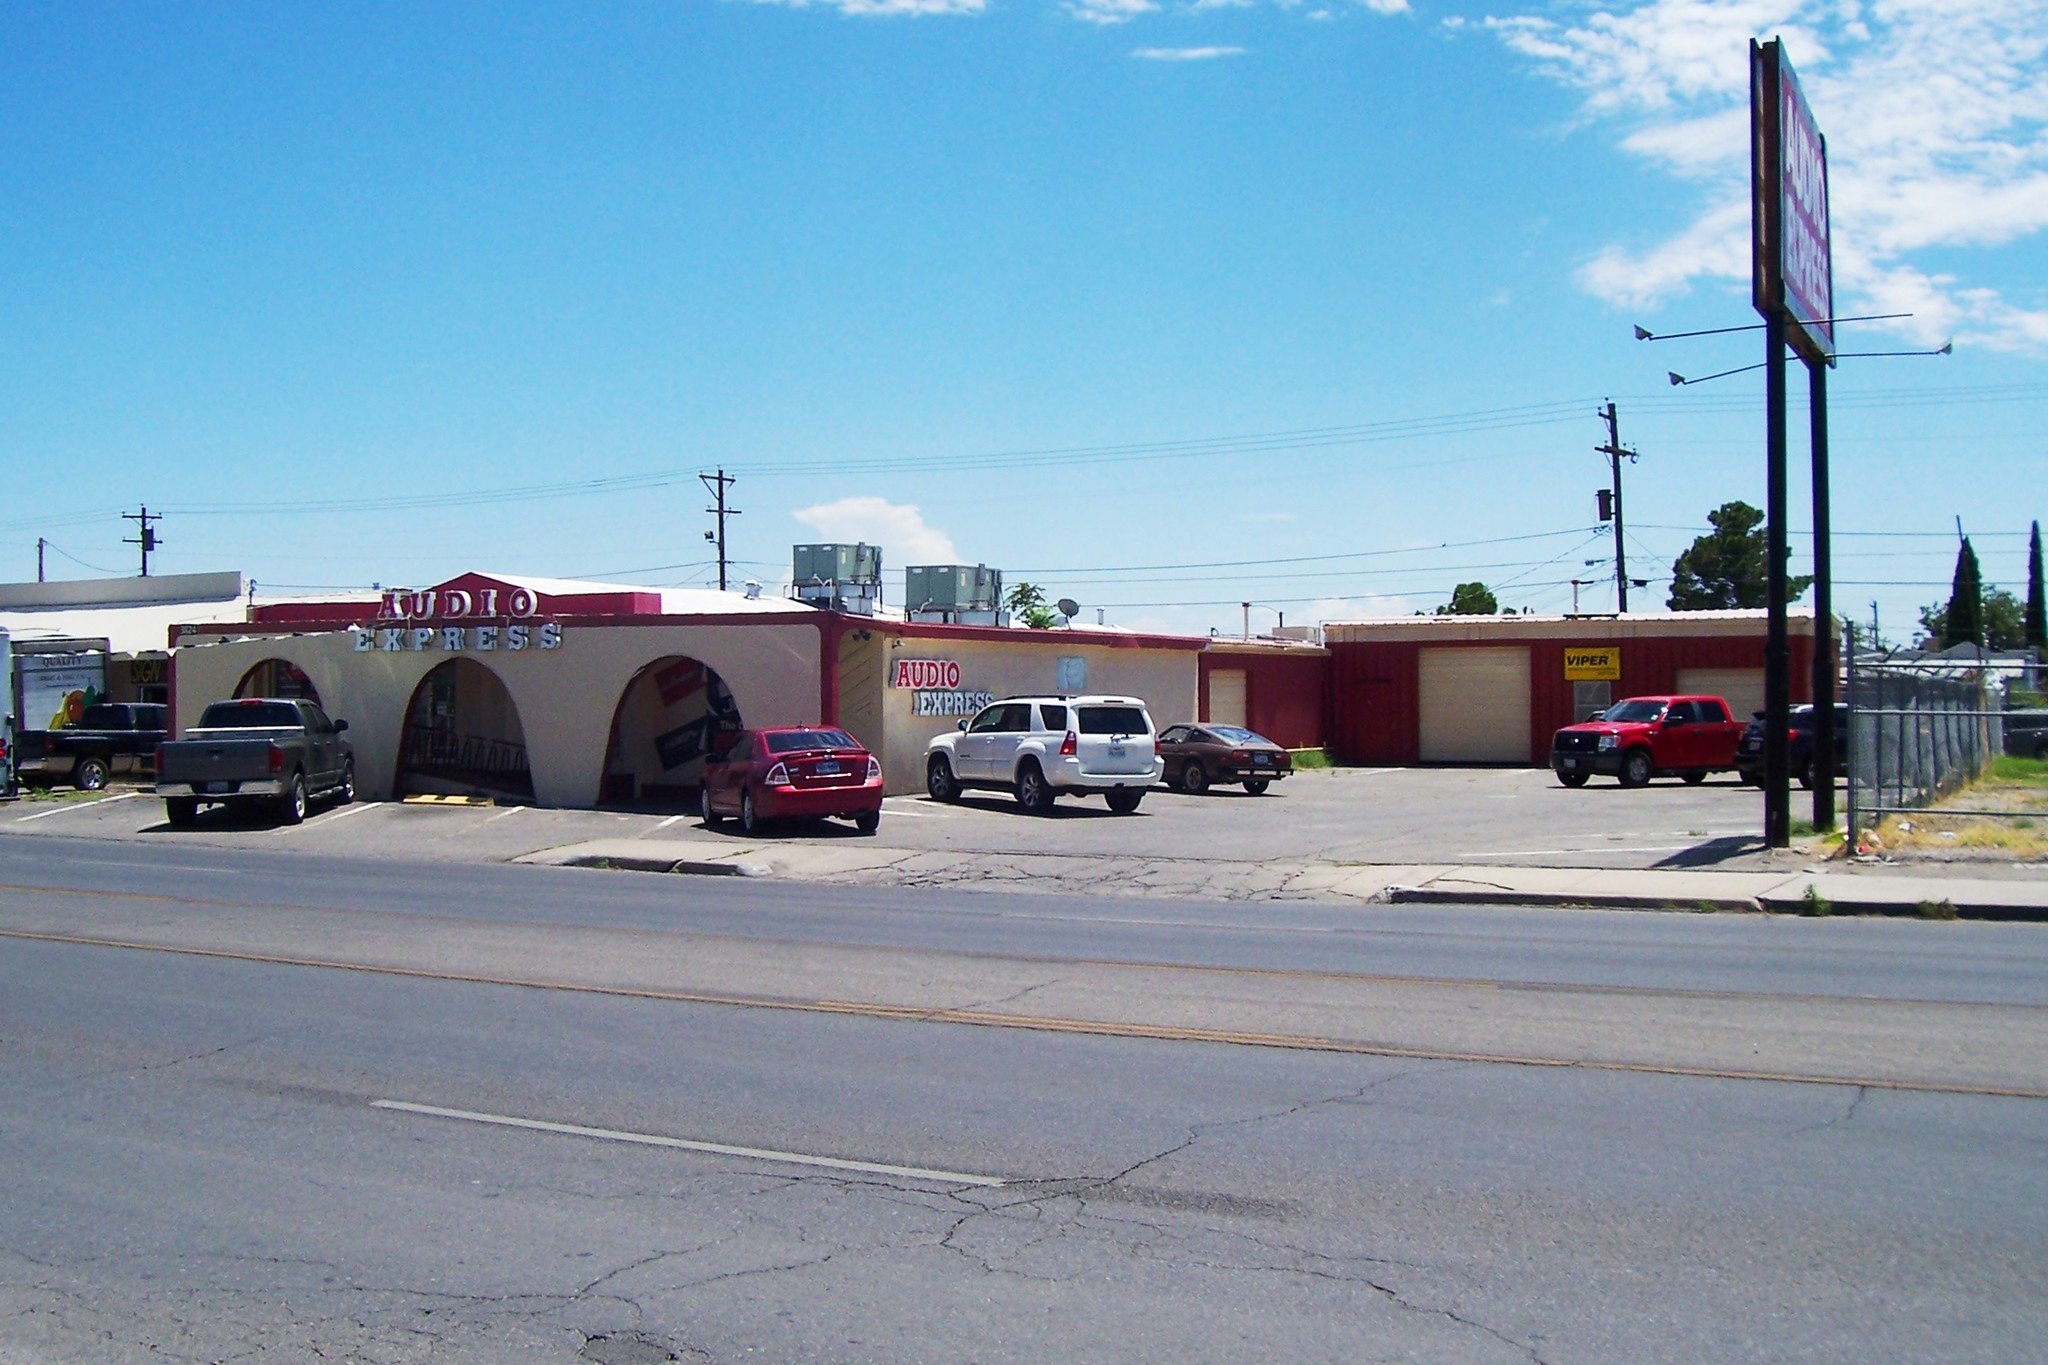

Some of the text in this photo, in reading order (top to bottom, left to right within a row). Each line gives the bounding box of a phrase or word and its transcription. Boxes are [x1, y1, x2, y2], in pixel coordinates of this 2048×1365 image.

[377, 587, 539, 620] AUDIO
[354, 624, 563, 652] EXPRESS
[43, 656, 82, 668] QUALITY
[896, 659, 960, 689] AUDIO
[1567, 656, 1609, 666] VIPER
